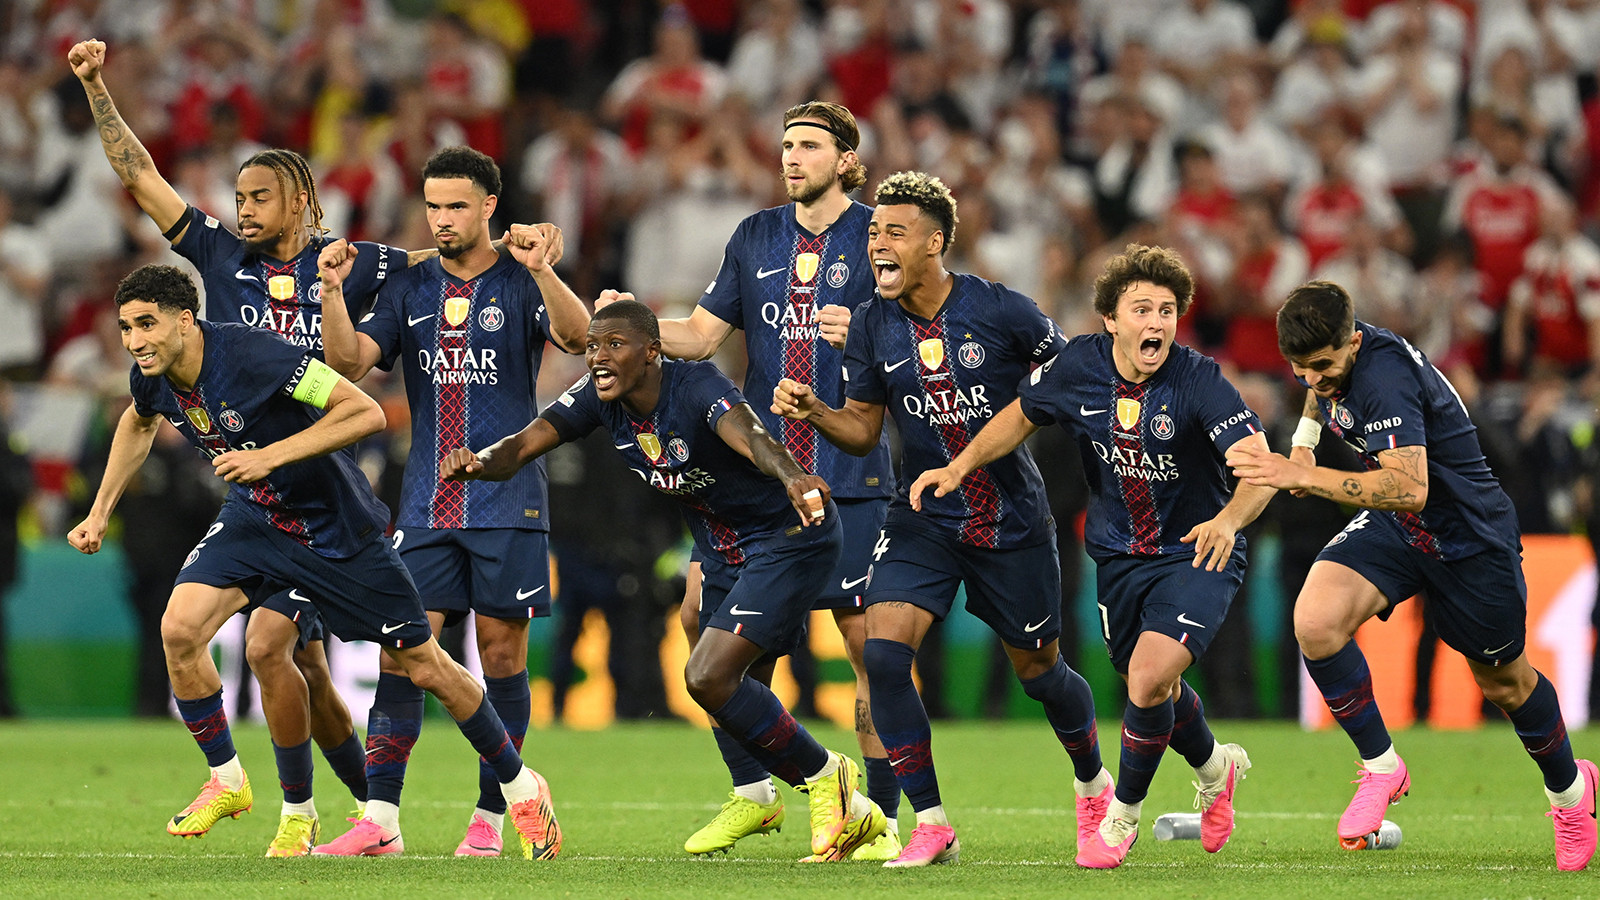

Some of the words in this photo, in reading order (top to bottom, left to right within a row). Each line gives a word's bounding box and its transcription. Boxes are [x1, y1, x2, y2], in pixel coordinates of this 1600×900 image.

[376, 243, 388, 280] BEYO
[240, 304, 322, 336] QATAR
[761, 302, 823, 329] QATA
[279, 333, 324, 351] WAYS
[778, 325, 823, 341] AIRWA
[418, 347, 498, 375] QATAR
[432, 370, 498, 386] AIRWAYS
[305, 379, 321, 404] ESPECT
[903, 384, 989, 419] QATAR
[929, 404, 993, 426] AIRWAYS
[1209, 409, 1252, 442] BEYOND
[1364, 416, 1402, 435] YOND
[1092, 440, 1177, 471] QATAR
[657, 475, 717, 496] WAYS
[1113, 464, 1180, 482] AIRWAYS
